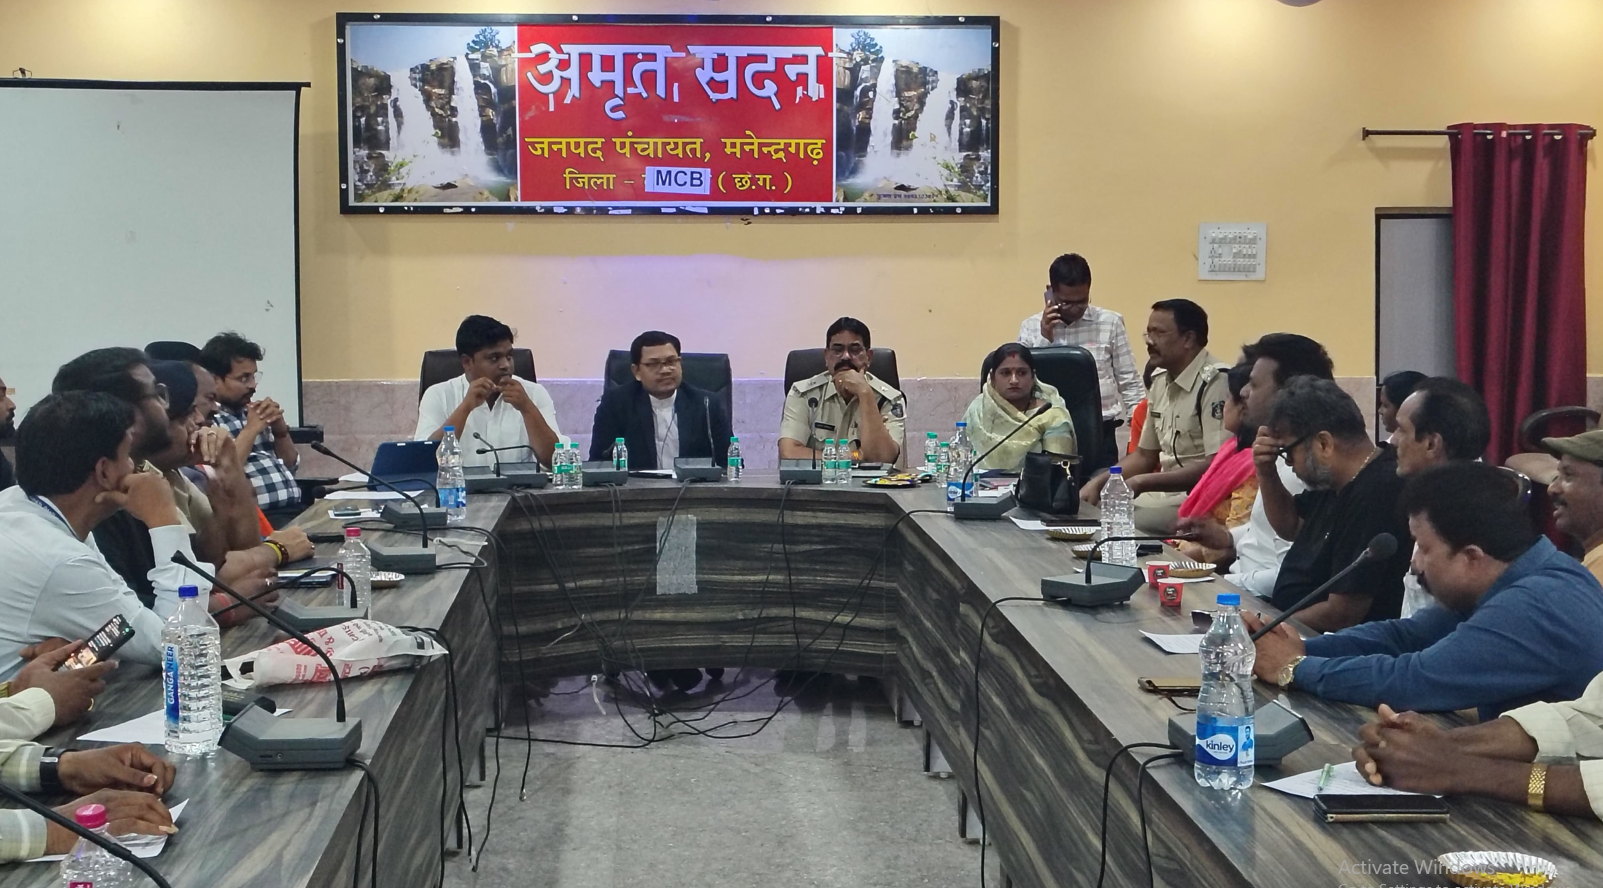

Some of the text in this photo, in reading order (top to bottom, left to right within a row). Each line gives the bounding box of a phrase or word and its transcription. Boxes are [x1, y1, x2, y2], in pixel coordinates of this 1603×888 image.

[526, 43, 825, 120] अमृत सदन
[524, 131, 826, 166] जनपद पंचायत, मनेन्द्रगढ़
[563, 168, 616, 190] जिला
[655, 169, 704, 188] MCB
[1205, 740, 1235, 753] kinley
